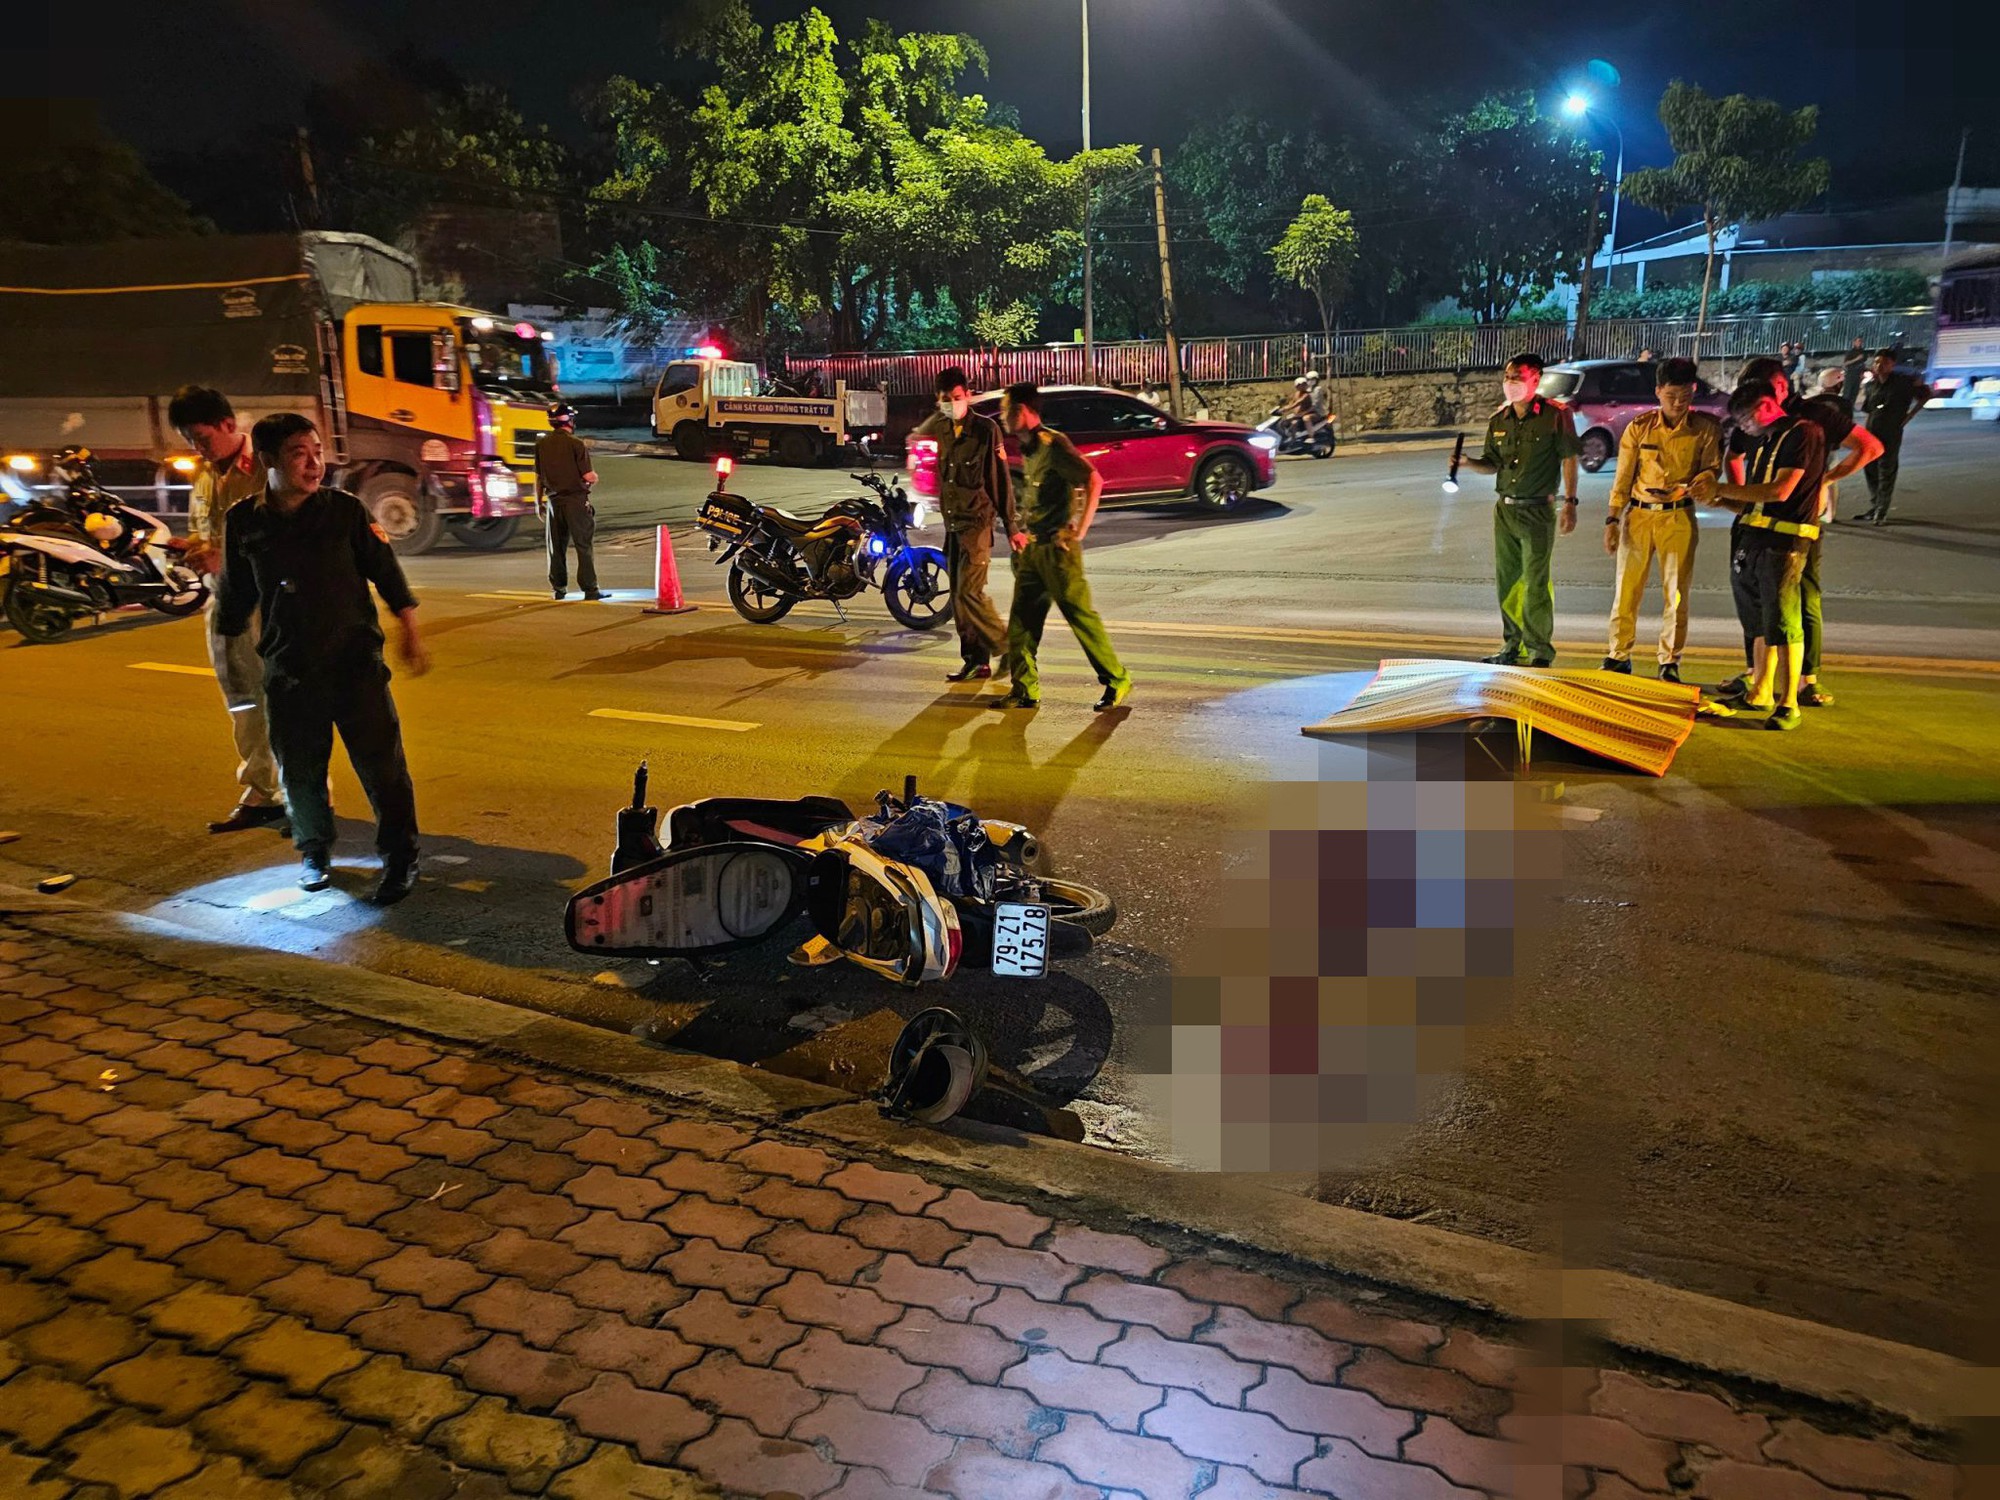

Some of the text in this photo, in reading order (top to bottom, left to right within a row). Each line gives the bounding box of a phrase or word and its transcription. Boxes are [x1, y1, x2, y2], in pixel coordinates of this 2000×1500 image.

[743, 402, 756, 412] SÁT
[758, 403, 774, 412] GIAO
[775, 403, 799, 413] THÔNG
[707, 504, 740, 526] POLICE
[996, 915, 1021, 966] 79-Z1
[1020, 908, 1046, 973] 175.78
